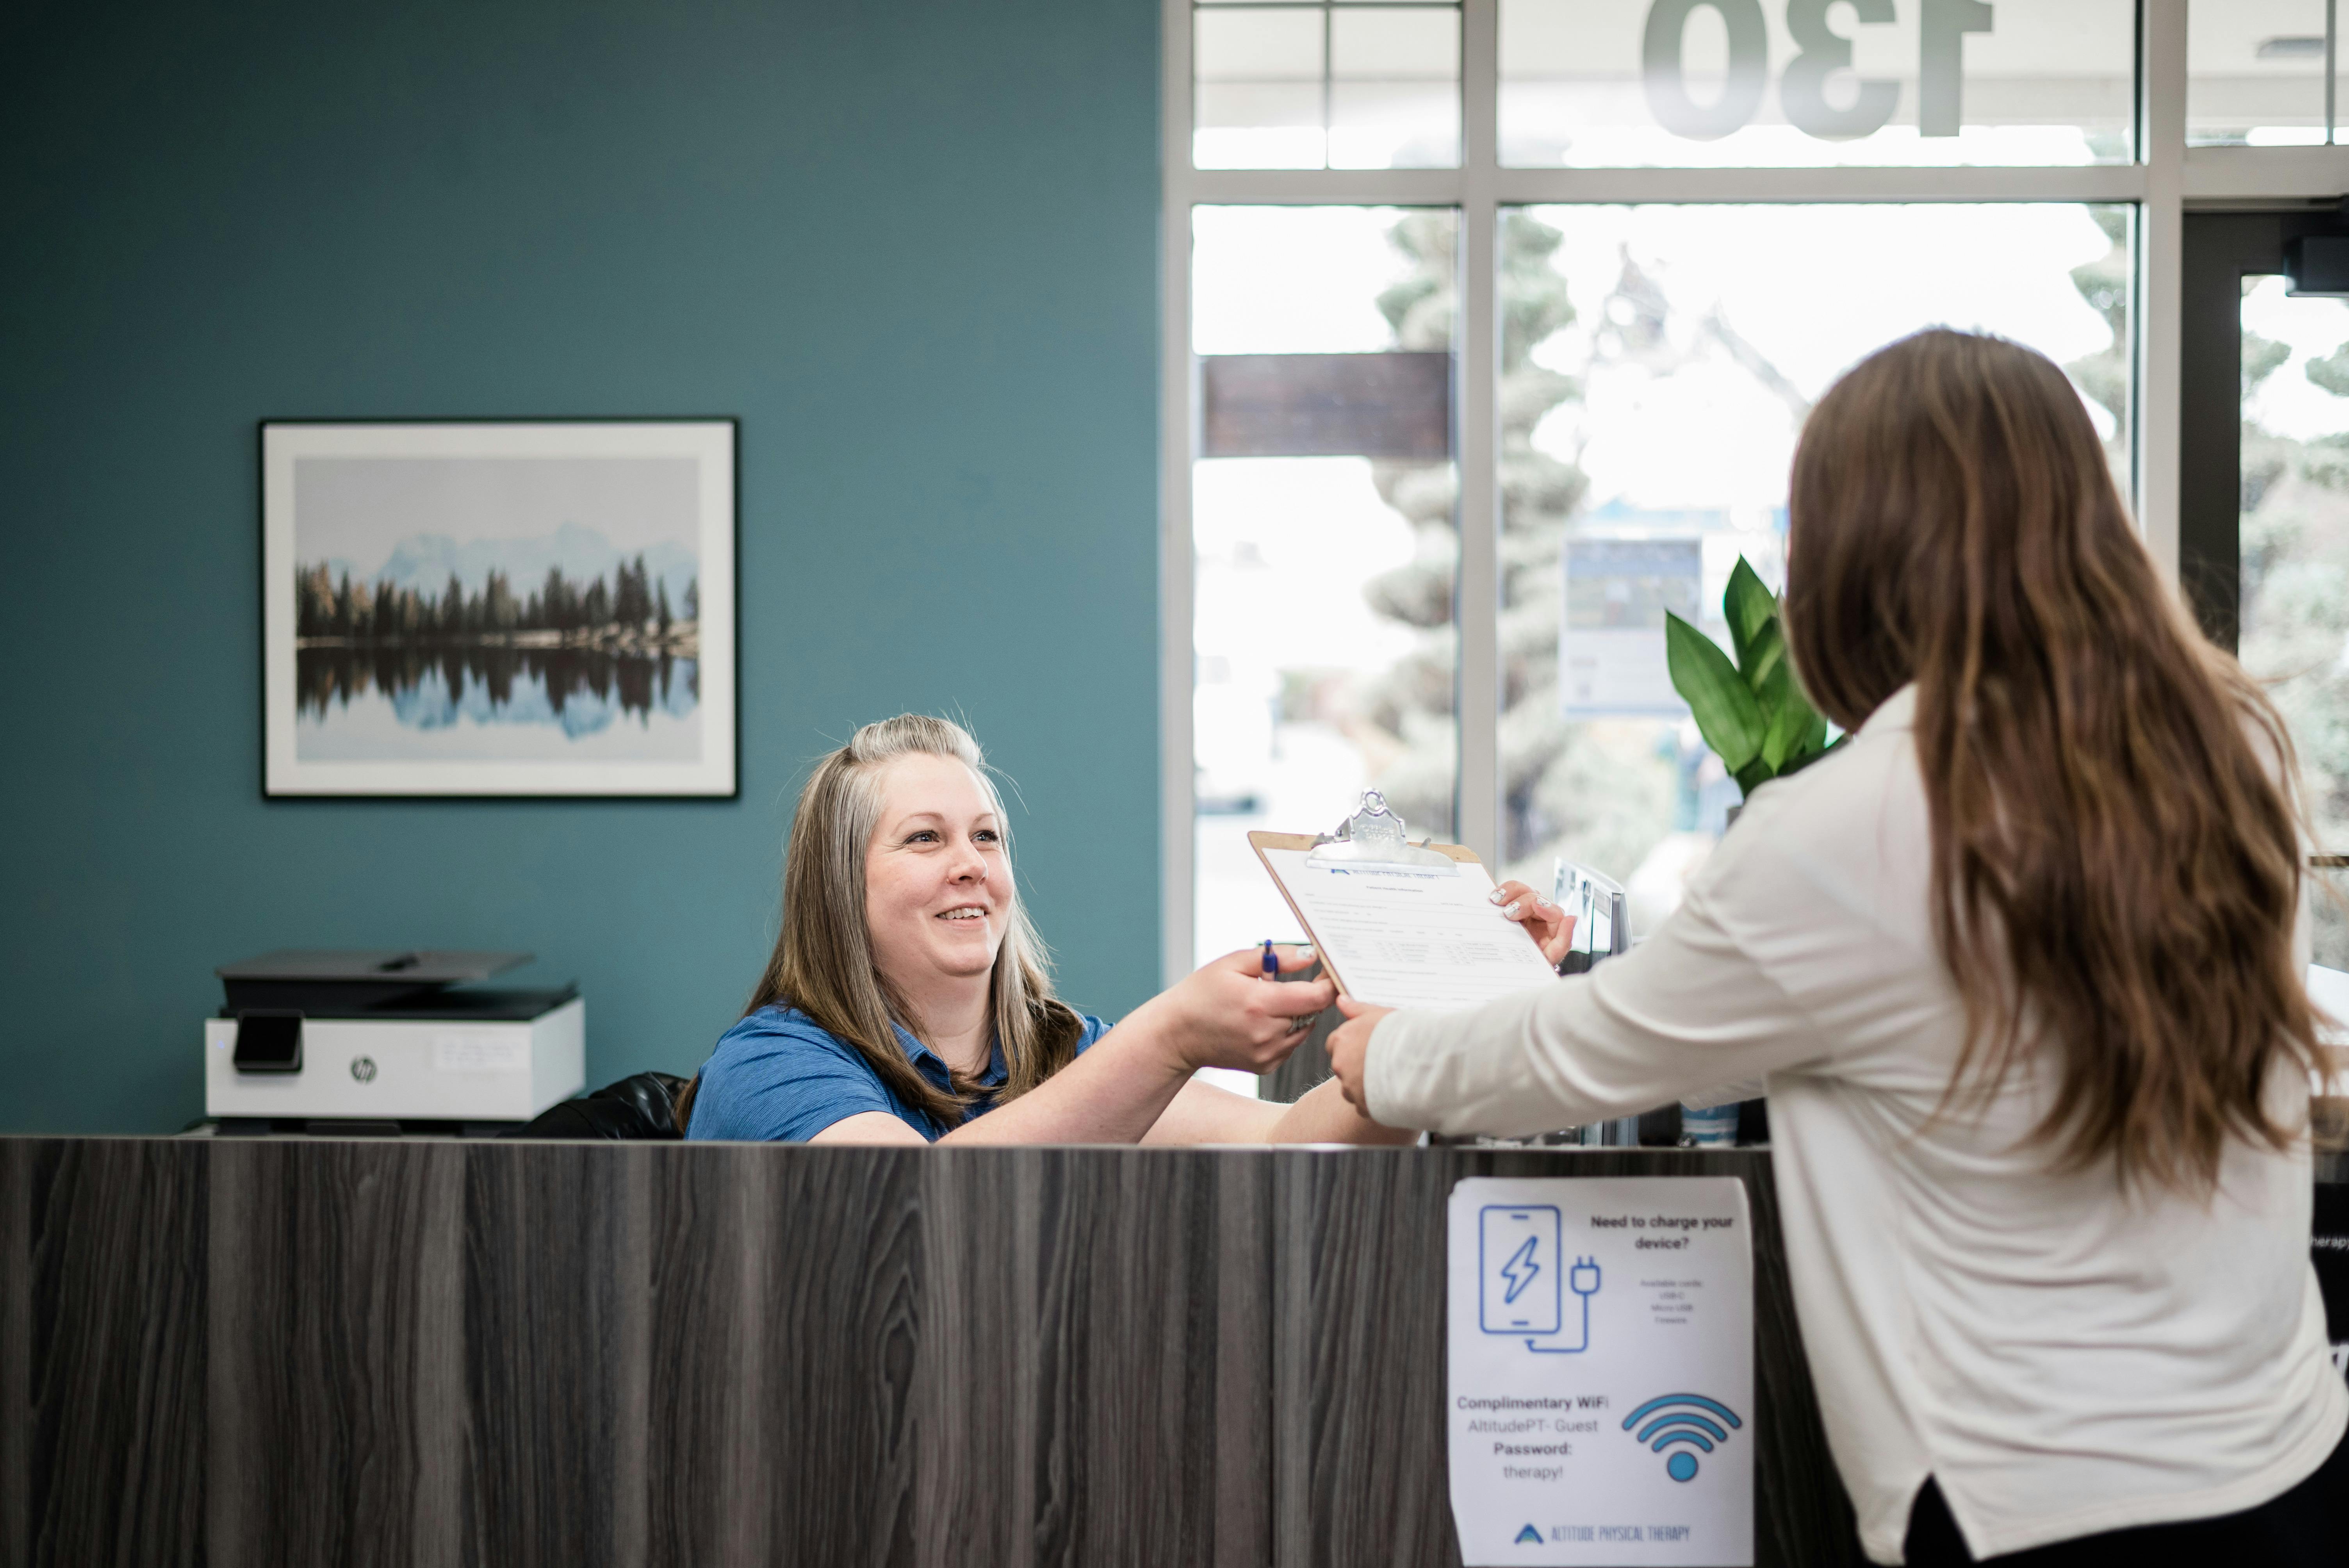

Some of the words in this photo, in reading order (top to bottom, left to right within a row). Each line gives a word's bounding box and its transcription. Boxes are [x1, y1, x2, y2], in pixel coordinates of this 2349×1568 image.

[1591, 1216, 1627, 1228] Need
[1631, 1217, 1645, 1228] to
[1649, 1214, 1698, 1231] charge
[1702, 1217, 1733, 1231] your
[1635, 1236, 1689, 1249] device?
[1457, 1396, 1572, 1411] Complimentary
[1577, 1396, 1609, 1409] WiFi
[1555, 1419, 1599, 1433] Guest
[1494, 1442, 1573, 1455] Password:
[1503, 1465, 1564, 1480] therapy!
[1551, 1525, 1595, 1542] ALTITUDE
[1600, 1526, 1644, 1542] PHYSICAL
[1649, 1526, 1690, 1542] THERAPY
